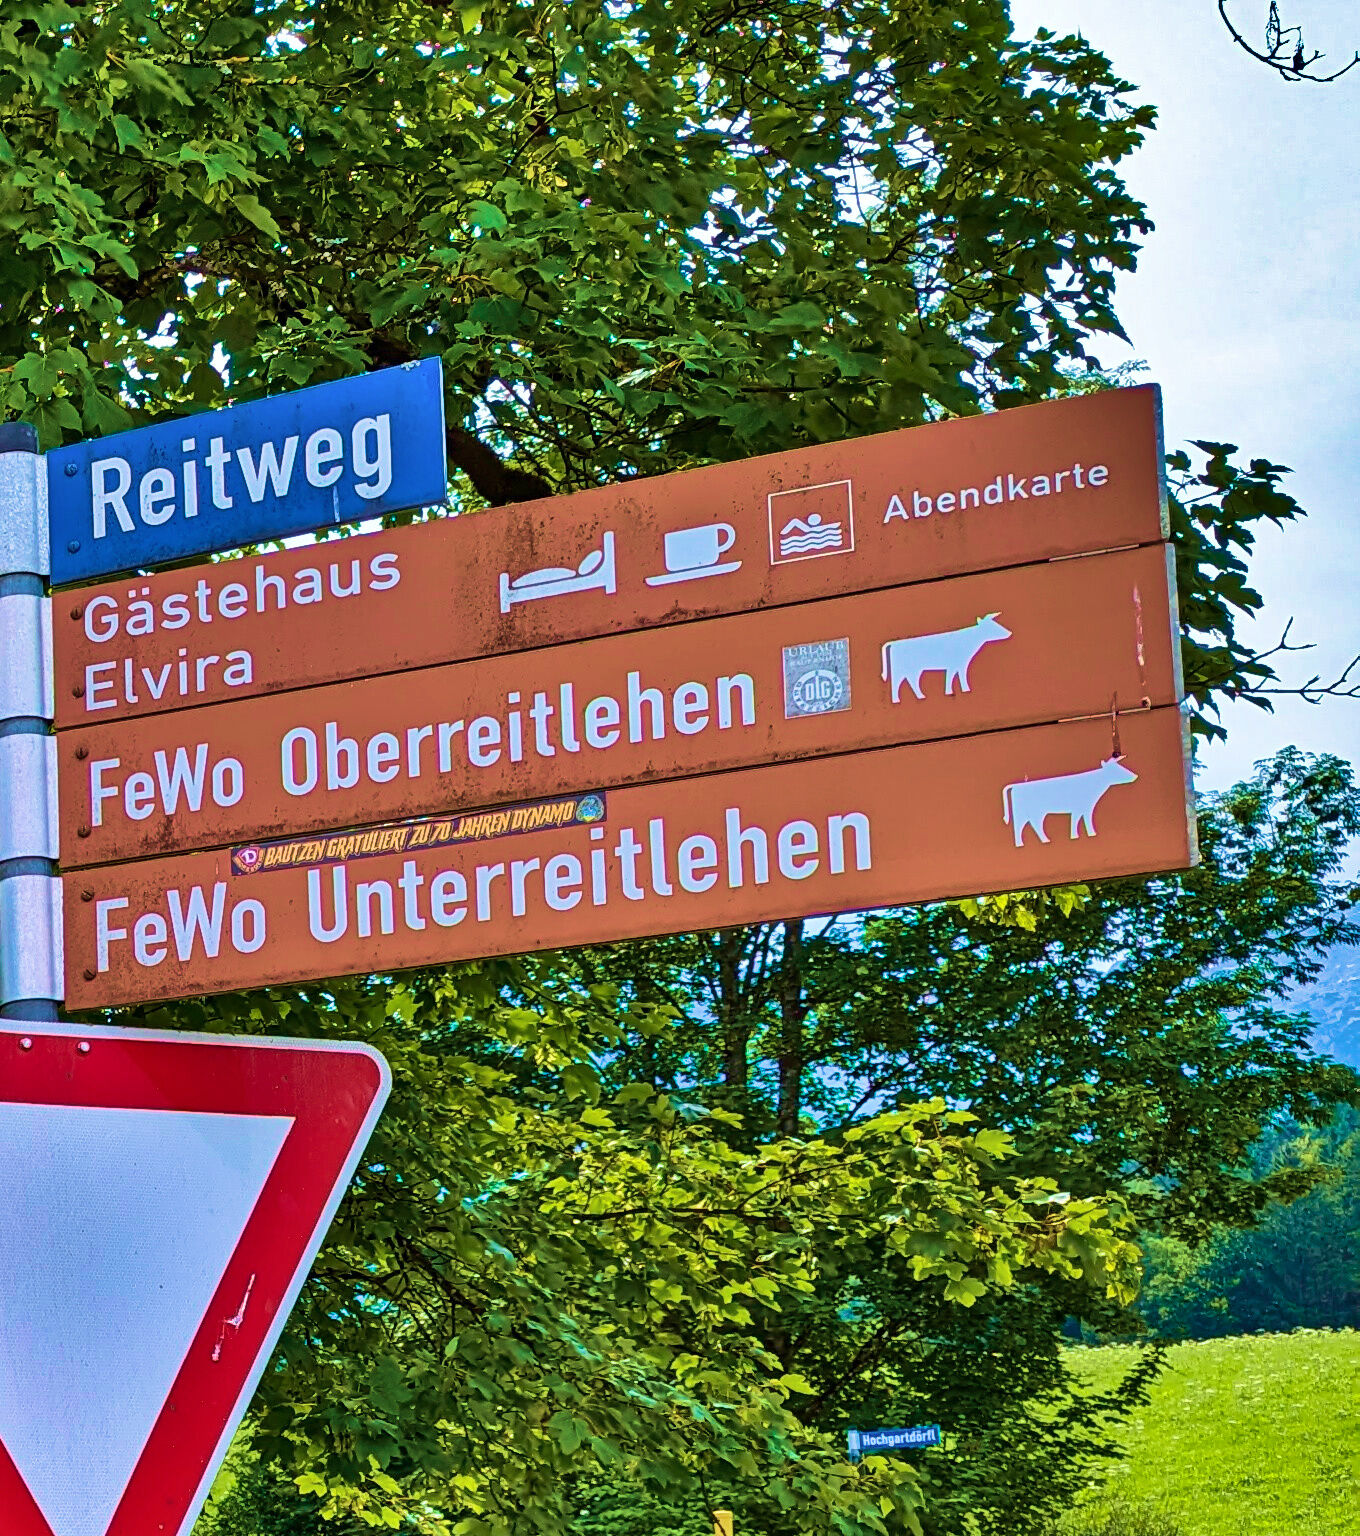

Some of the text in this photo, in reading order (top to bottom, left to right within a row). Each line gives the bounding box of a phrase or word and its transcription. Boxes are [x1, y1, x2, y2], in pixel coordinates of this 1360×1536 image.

[91, 413, 393, 539] Reitweg
[882, 463, 1109, 525] Abendkarte
[84, 551, 401, 643] Gästehaus
[85, 648, 255, 712] Elvira
[89, 743, 245, 827] FeWo
[280, 671, 756, 796] Oberreitlehen
[264, 839, 326, 868] BAUTZEN
[327, 831, 409, 860] GRATULIERT
[411, 824, 430, 844] ZU
[429, 822, 453, 844] 70
[454, 810, 512, 840] JAHREN
[511, 800, 577, 832] DYNAMO
[95, 807, 872, 973] FeWo Unterreitlehen
[862, 1428, 936, 1447] Hochgartdörfl
